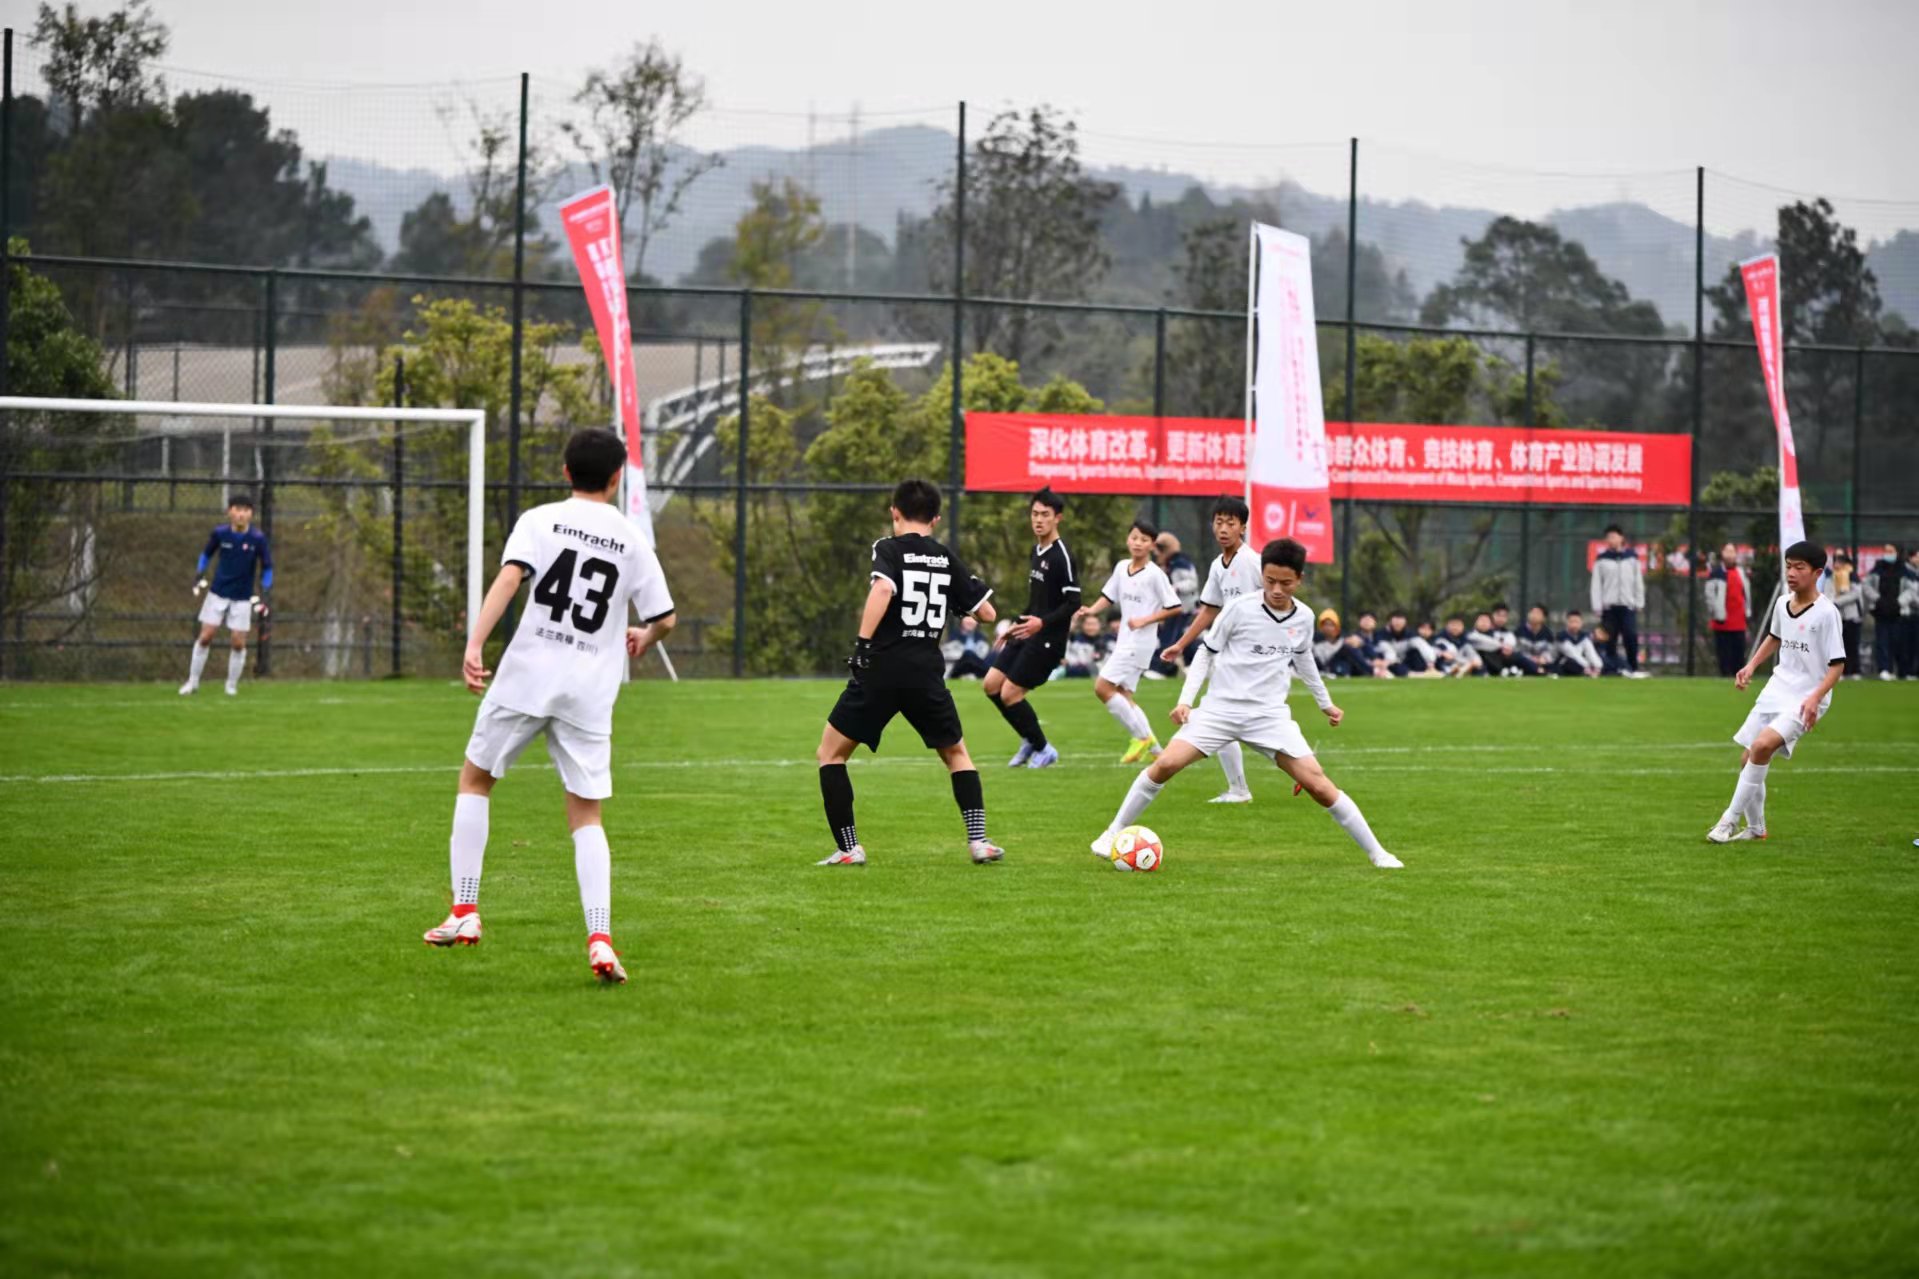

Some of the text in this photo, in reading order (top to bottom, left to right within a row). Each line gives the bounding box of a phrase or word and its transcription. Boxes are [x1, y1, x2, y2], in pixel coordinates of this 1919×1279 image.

[552, 523, 626, 554] Eintracht
[534, 547, 620, 635] 43
[901, 570, 951, 629] 55
